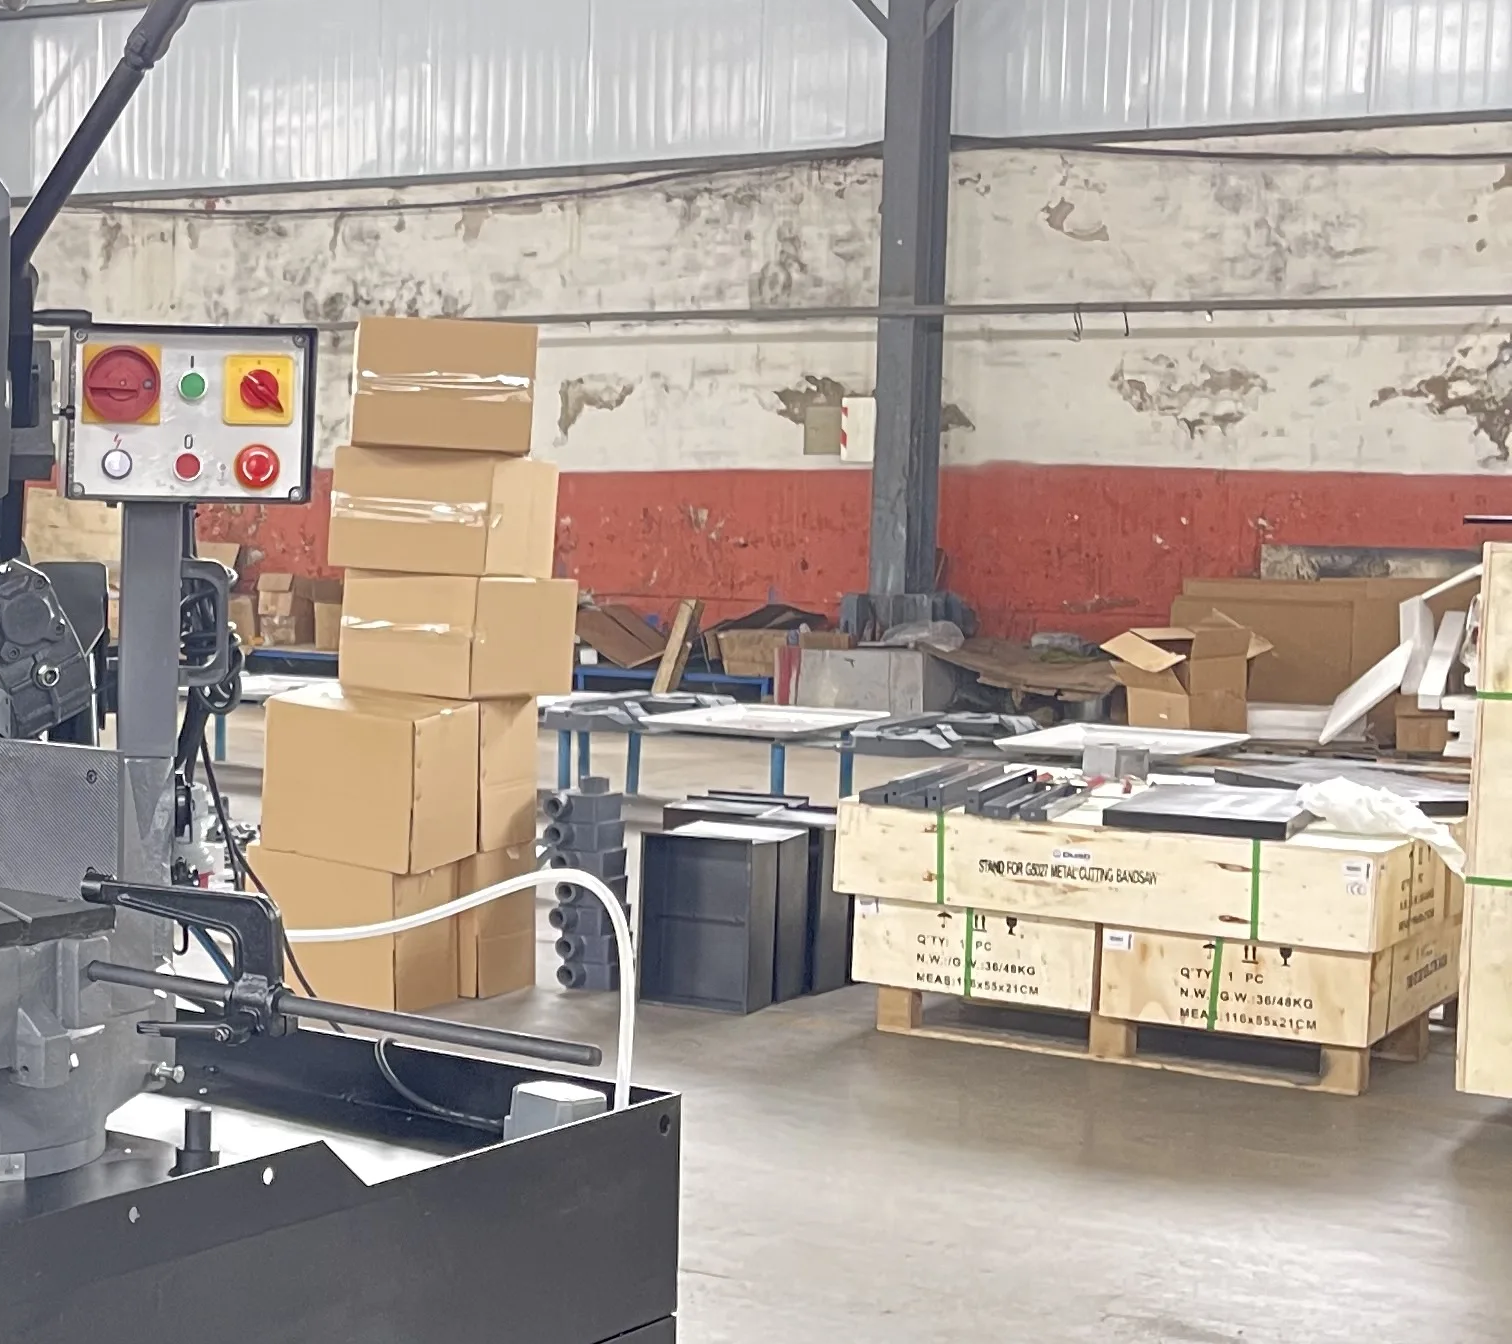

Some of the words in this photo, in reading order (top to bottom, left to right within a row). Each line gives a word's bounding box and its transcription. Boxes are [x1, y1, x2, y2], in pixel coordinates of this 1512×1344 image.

[1007, 861, 1023, 875] FOR
[1050, 864, 1076, 880] METAL
[976, 940, 992, 951] PC
[1245, 973, 1264, 984] PC
